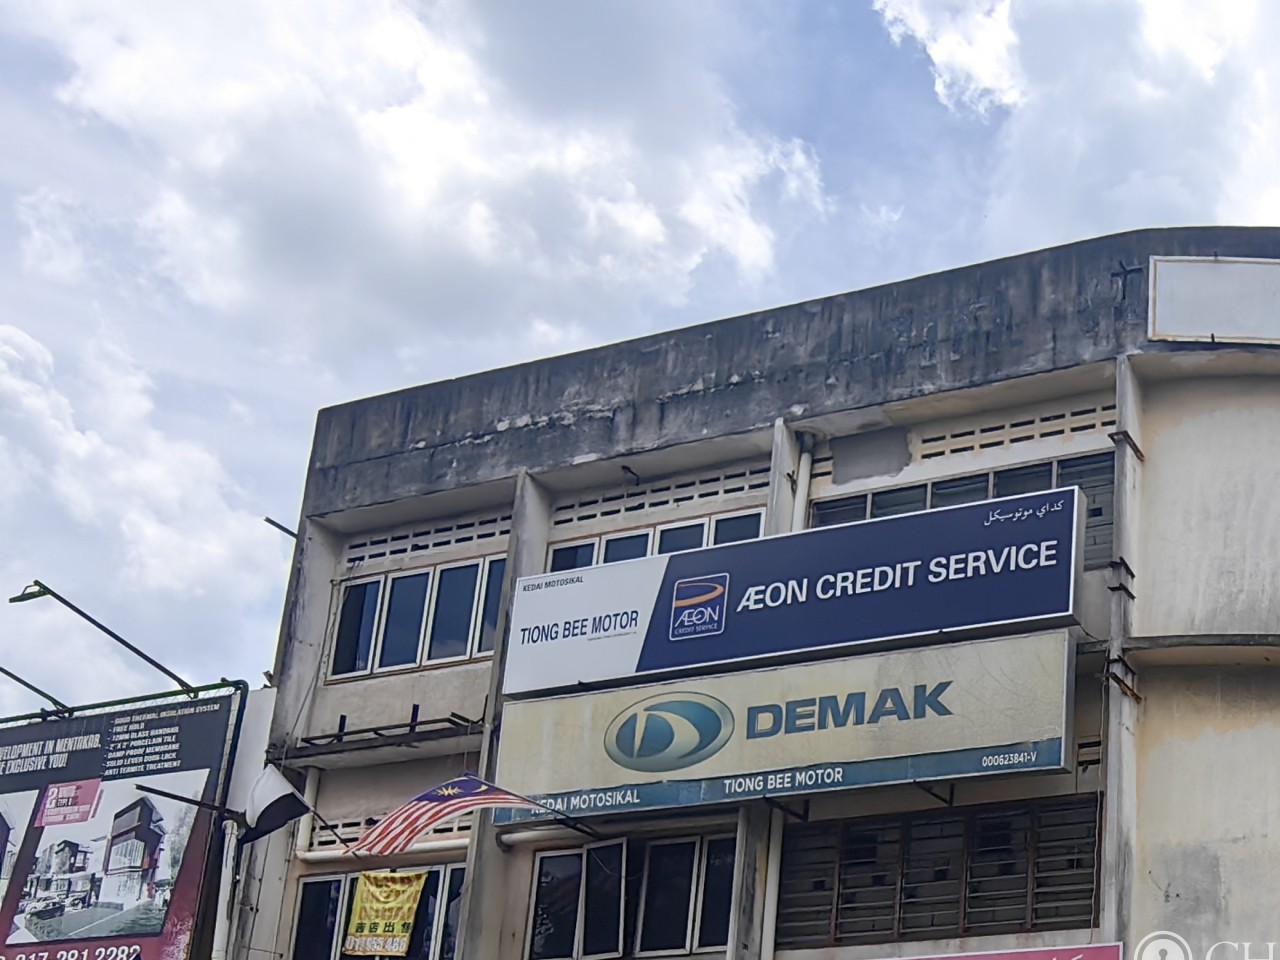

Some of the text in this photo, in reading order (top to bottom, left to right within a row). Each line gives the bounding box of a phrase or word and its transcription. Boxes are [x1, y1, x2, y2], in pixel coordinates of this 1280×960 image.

[815, 561, 922, 600] CREDIT
[927, 540, 1058, 583] SERVICE
[522, 575, 584, 592] KEDAI MOTOSIKAL
[521, 623, 559, 645] TIONG
[562, 617, 589, 639] BEE
[590, 610, 639, 634] MOTOR
[746, 680, 954, 740] DEMAK
[44, 740, 55, 755] IN
[5, 756, 48, 774] EXCLUSIVE
[981, 751, 1038, 768] 000623841-V
[723, 767, 843, 794] TIONG BEE MOTOR
[570, 789, 641, 811] MOTOSIKAL
